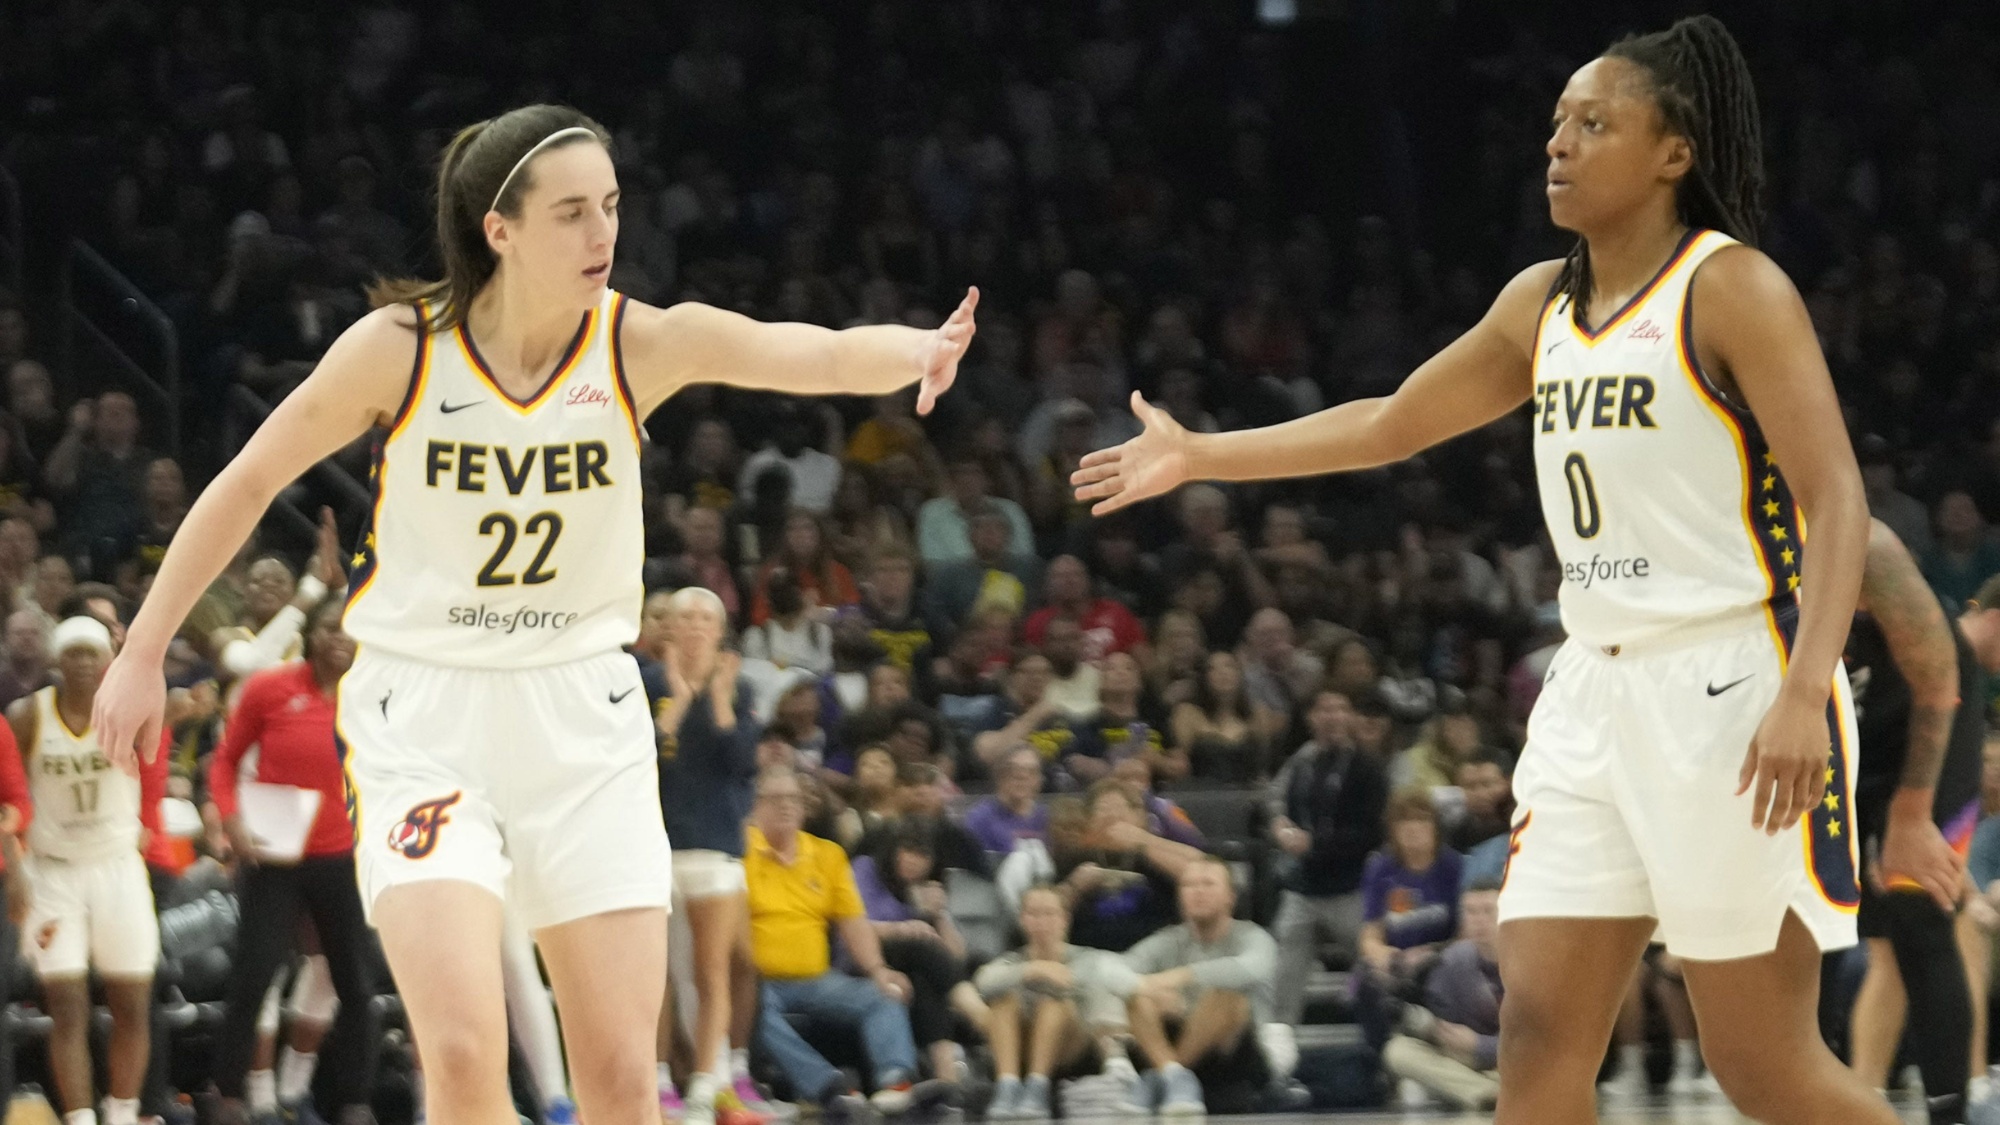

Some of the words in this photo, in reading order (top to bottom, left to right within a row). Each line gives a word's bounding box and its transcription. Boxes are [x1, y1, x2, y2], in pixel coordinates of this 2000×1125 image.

[1628, 319, 1665, 344] Lilly
[566, 383, 611, 408] Lilly
[426, 439, 614, 496] FEVER
[1564, 451, 1602, 540] 0
[476, 510, 563, 587] 22
[1562, 553, 1650, 589] esforce
[447, 603, 579, 634] salesforce
